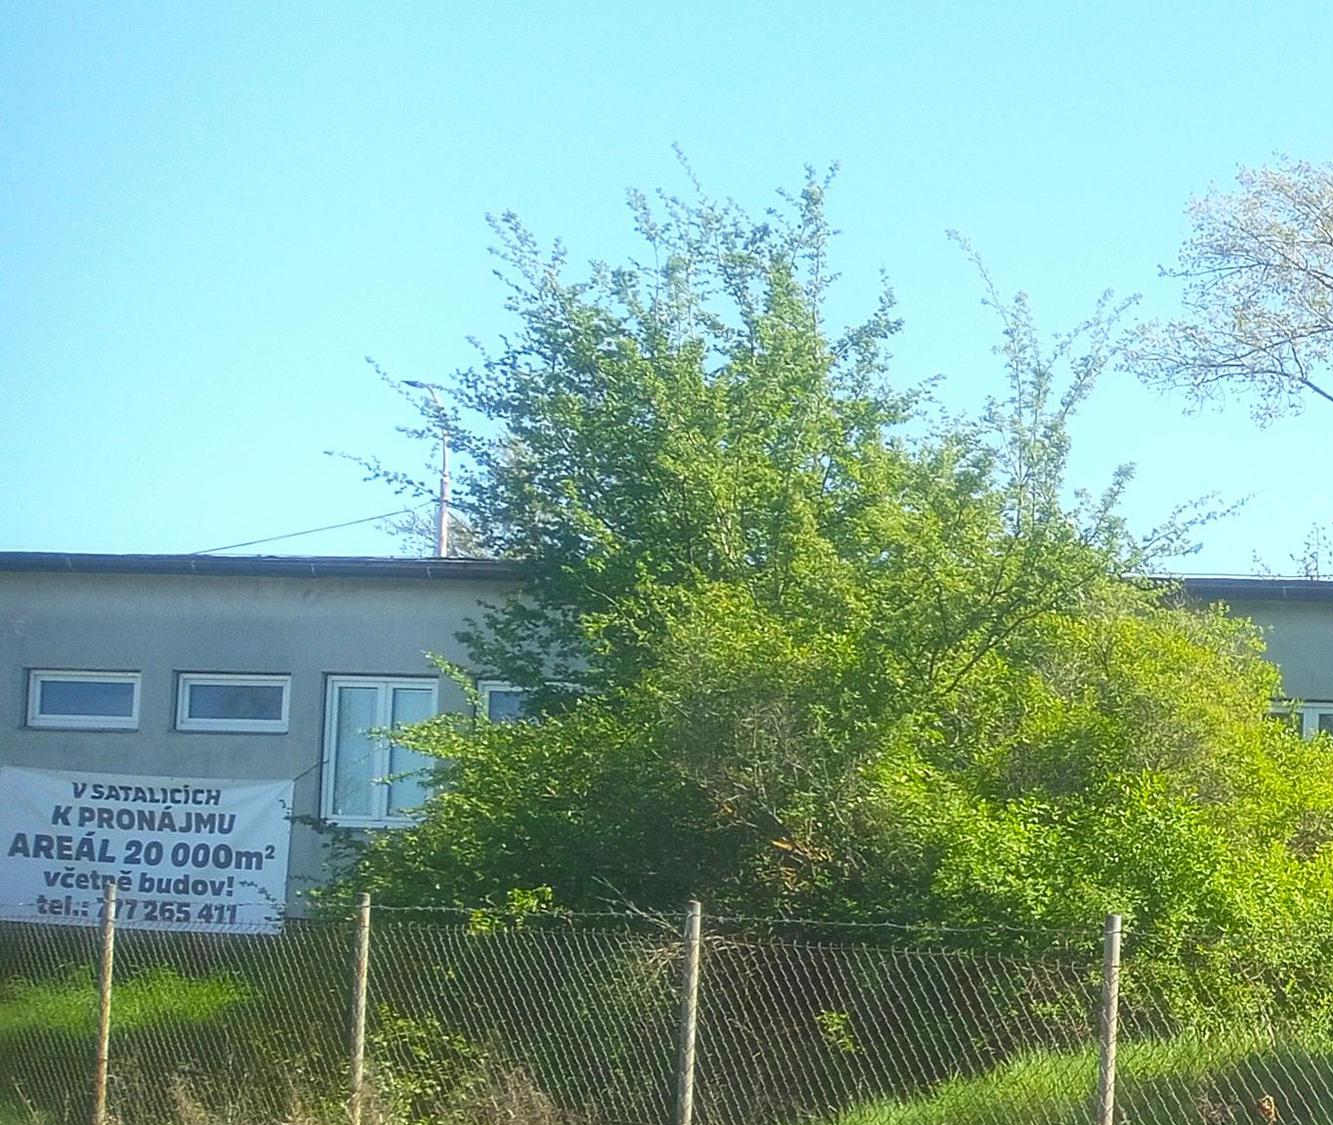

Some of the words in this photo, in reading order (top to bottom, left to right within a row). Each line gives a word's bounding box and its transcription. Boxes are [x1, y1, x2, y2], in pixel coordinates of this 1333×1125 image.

[72, 782, 88, 799] V
[90, 783, 222, 806] SATALICÍCH
[51, 805, 73, 826] K
[78, 805, 236, 834] PRONÁJMU
[7, 831, 116, 863] AREÁL
[123, 840, 164, 866] 20
[44, 867, 132, 892] včetně
[138, 872, 235, 897] budov!
[144, 900, 191, 923] 265
[197, 902, 237, 924] 411
